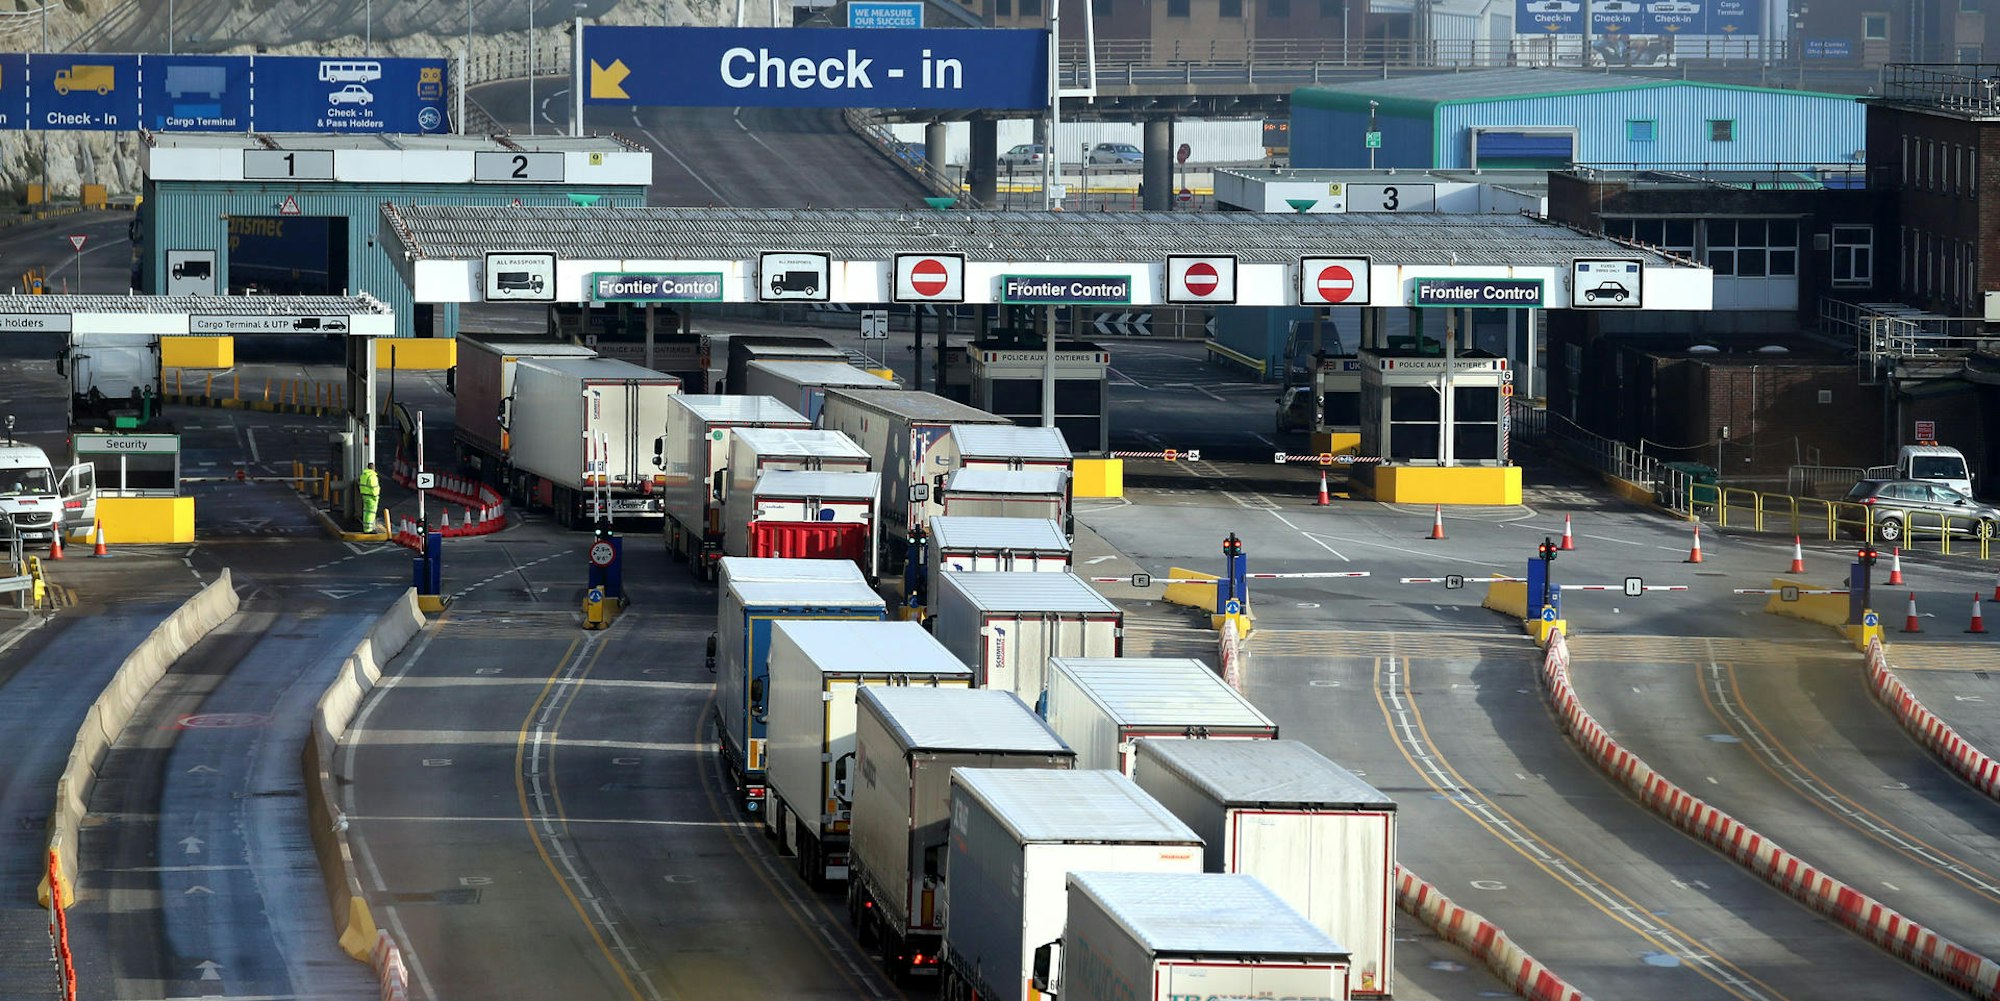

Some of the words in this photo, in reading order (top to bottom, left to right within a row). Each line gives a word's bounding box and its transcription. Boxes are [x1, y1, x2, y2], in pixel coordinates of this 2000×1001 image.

[854, 9, 869, 17] WE
[871, 9, 912, 17] MEASURE
[1534, 14, 1572, 23] Check-in
[1594, 14, 1630, 23] Check-in
[1654, 14, 1692, 23] Check-in
[720, 46, 873, 89] Check
[922, 50, 962, 89] in
[328, 108, 356, 117] Check
[364, 109, 373, 117] In
[47, 112, 90, 125] Check
[104, 112, 117, 125] In
[166, 117, 194, 128] Cargo
[198, 118, 236, 126] Terminal
[317, 119, 324, 127] &
[326, 119, 347, 127] Pass
[350, 119, 384, 128] Holders
[283, 153, 294, 176] 1
[512, 155, 528, 178] 2
[1382, 186, 1399, 210] 3
[599, 280, 658, 294] Frontier
[661, 280, 718, 294] Control
[1008, 282, 1066, 296] Frontier
[1070, 282, 1126, 297] Control
[1420, 285, 1479, 300] Frontier
[1484, 285, 1539, 300] Control
[6, 318, 44, 328] holders
[198, 320, 223, 330] Cargo
[1349, 361, 1361, 370] UK
[1505, 371, 1510, 380] 6
[106, 439, 148, 450] Security
[422, 476, 430, 484] A
